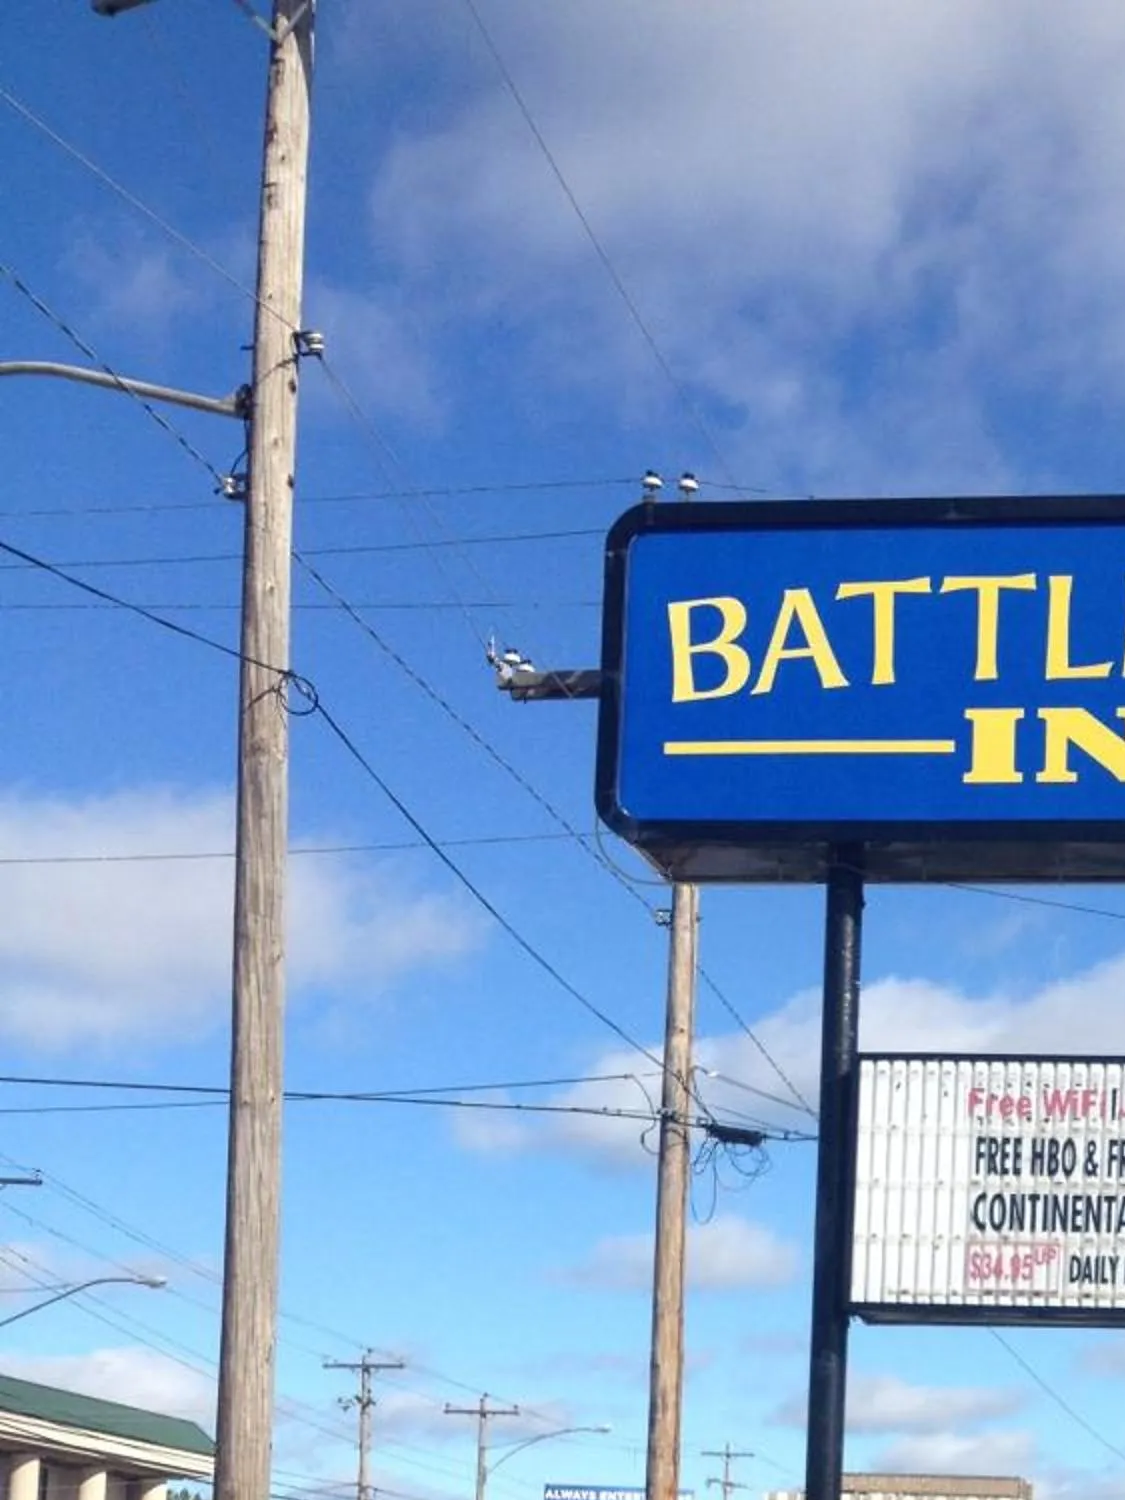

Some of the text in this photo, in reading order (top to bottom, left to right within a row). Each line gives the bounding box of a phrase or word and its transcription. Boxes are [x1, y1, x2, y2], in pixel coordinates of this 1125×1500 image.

[967, 1087, 1032, 1118] Free
[975, 1136, 1022, 1176] FREE
[1030, 1137, 1077, 1178] HBO
[1084, 1140, 1099, 1177] &
[1069, 1255, 1119, 1284] DAILY
